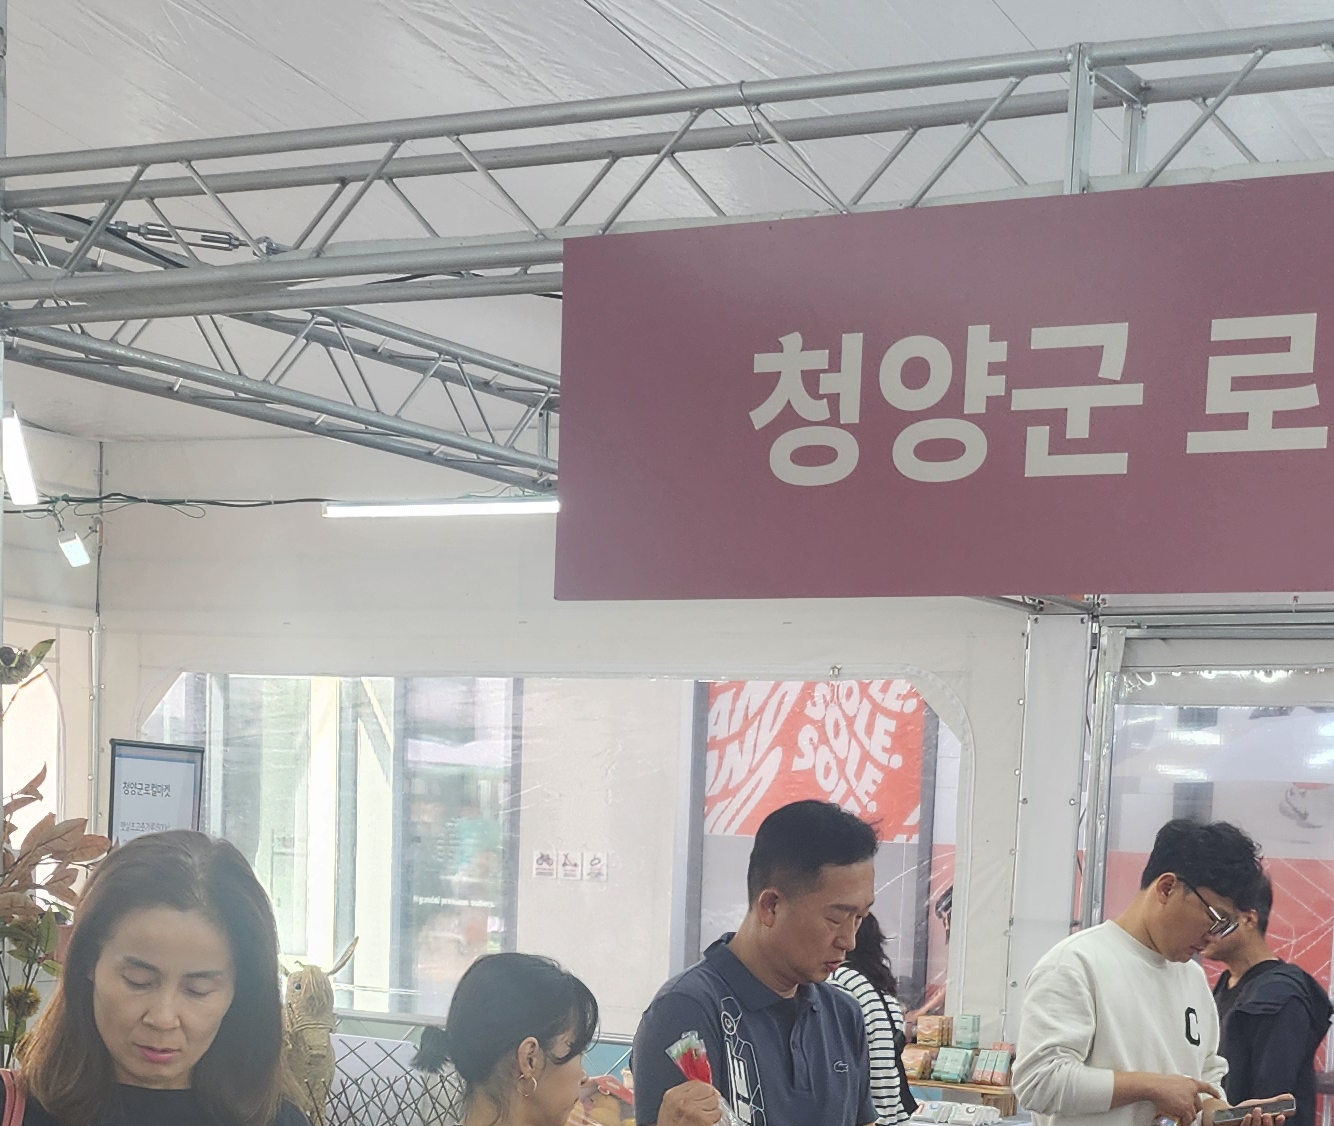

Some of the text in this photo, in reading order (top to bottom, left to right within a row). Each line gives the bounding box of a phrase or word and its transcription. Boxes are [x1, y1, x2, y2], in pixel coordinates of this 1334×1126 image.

[750, 319, 1146, 486] 청양군
[122, 781, 171, 797] 청양군로컬마켓
[1184, 1007, 1202, 1047] C
